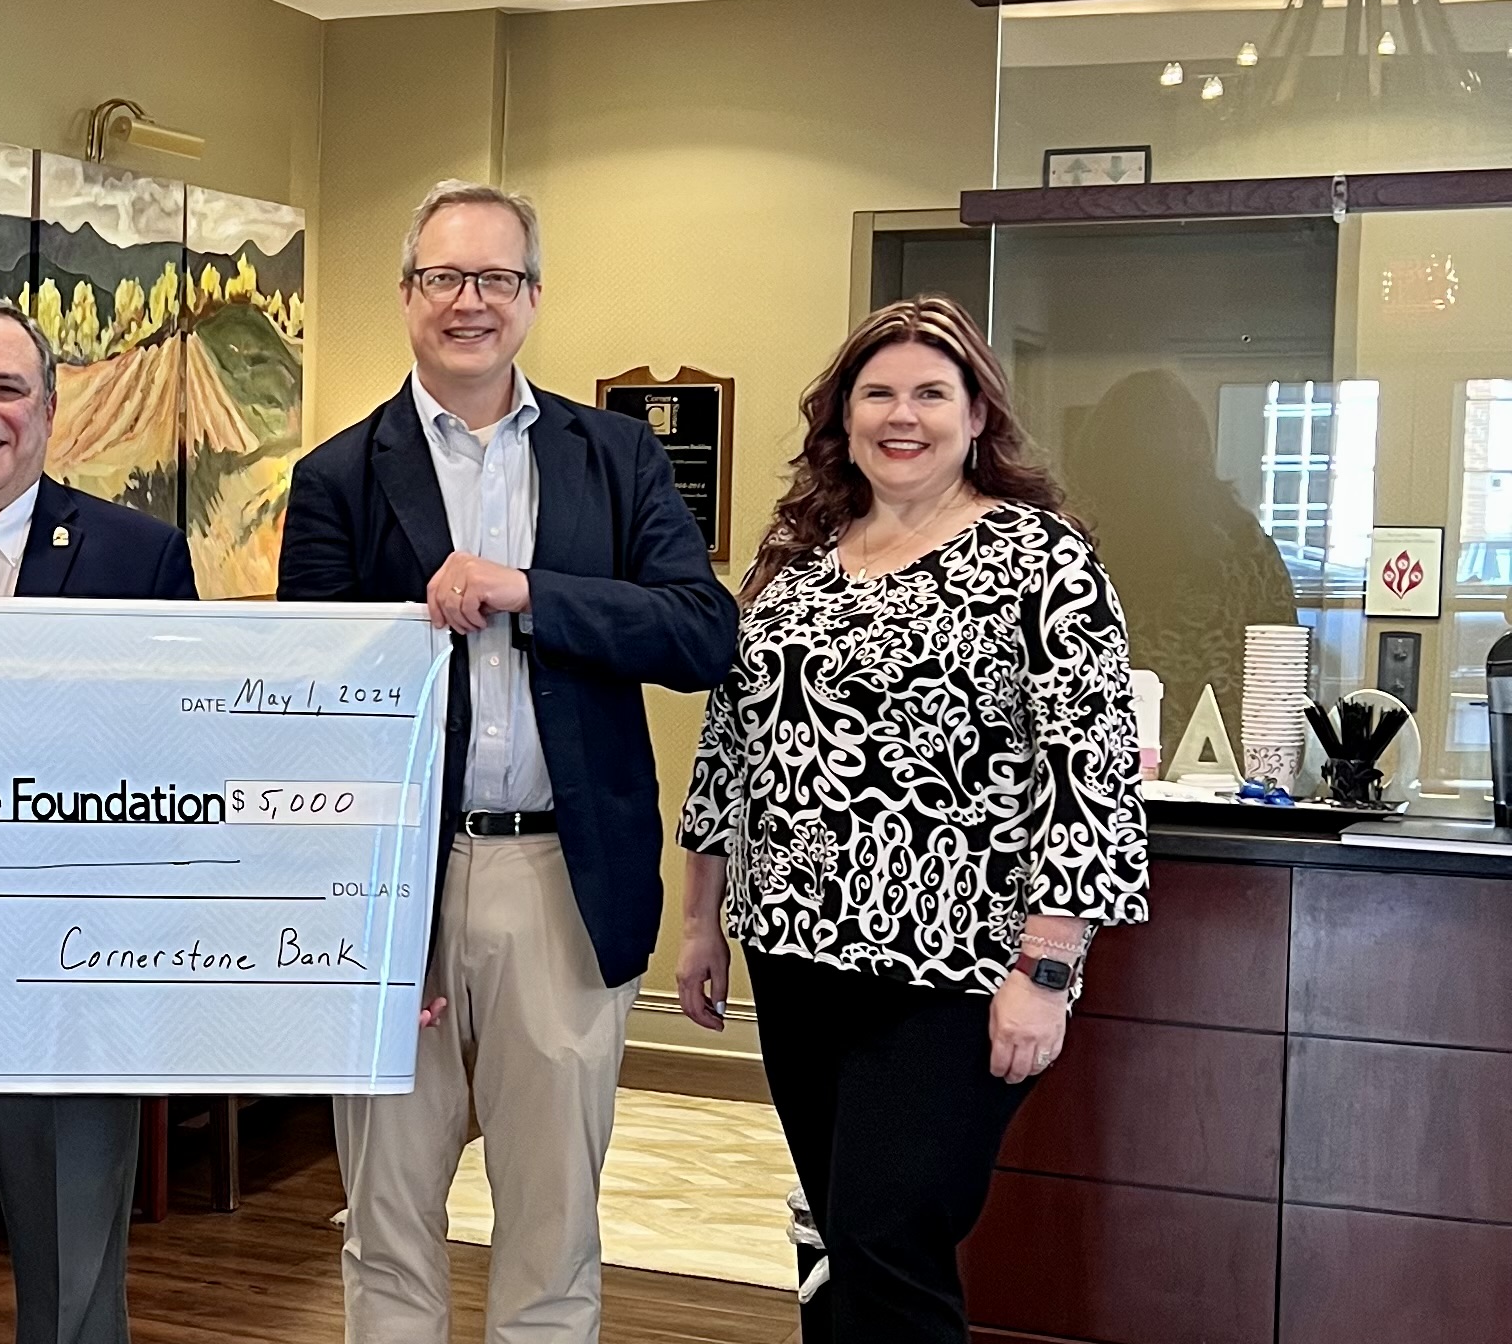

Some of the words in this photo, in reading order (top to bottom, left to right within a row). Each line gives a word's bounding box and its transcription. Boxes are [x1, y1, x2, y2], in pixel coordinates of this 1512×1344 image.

[181, 698, 226, 713] DATE
[235, 679, 292, 716] May
[306, 680, 323, 716] 1,
[338, 686, 401, 704] 2024
[12, 778, 226, 822] Foundation
[232, 789, 246, 813] $
[257, 788, 354, 820] 5,000
[332, 883, 411, 898] DOLAS
[61, 927, 256, 971] Cornerstone
[277, 928, 367, 971] Bank
